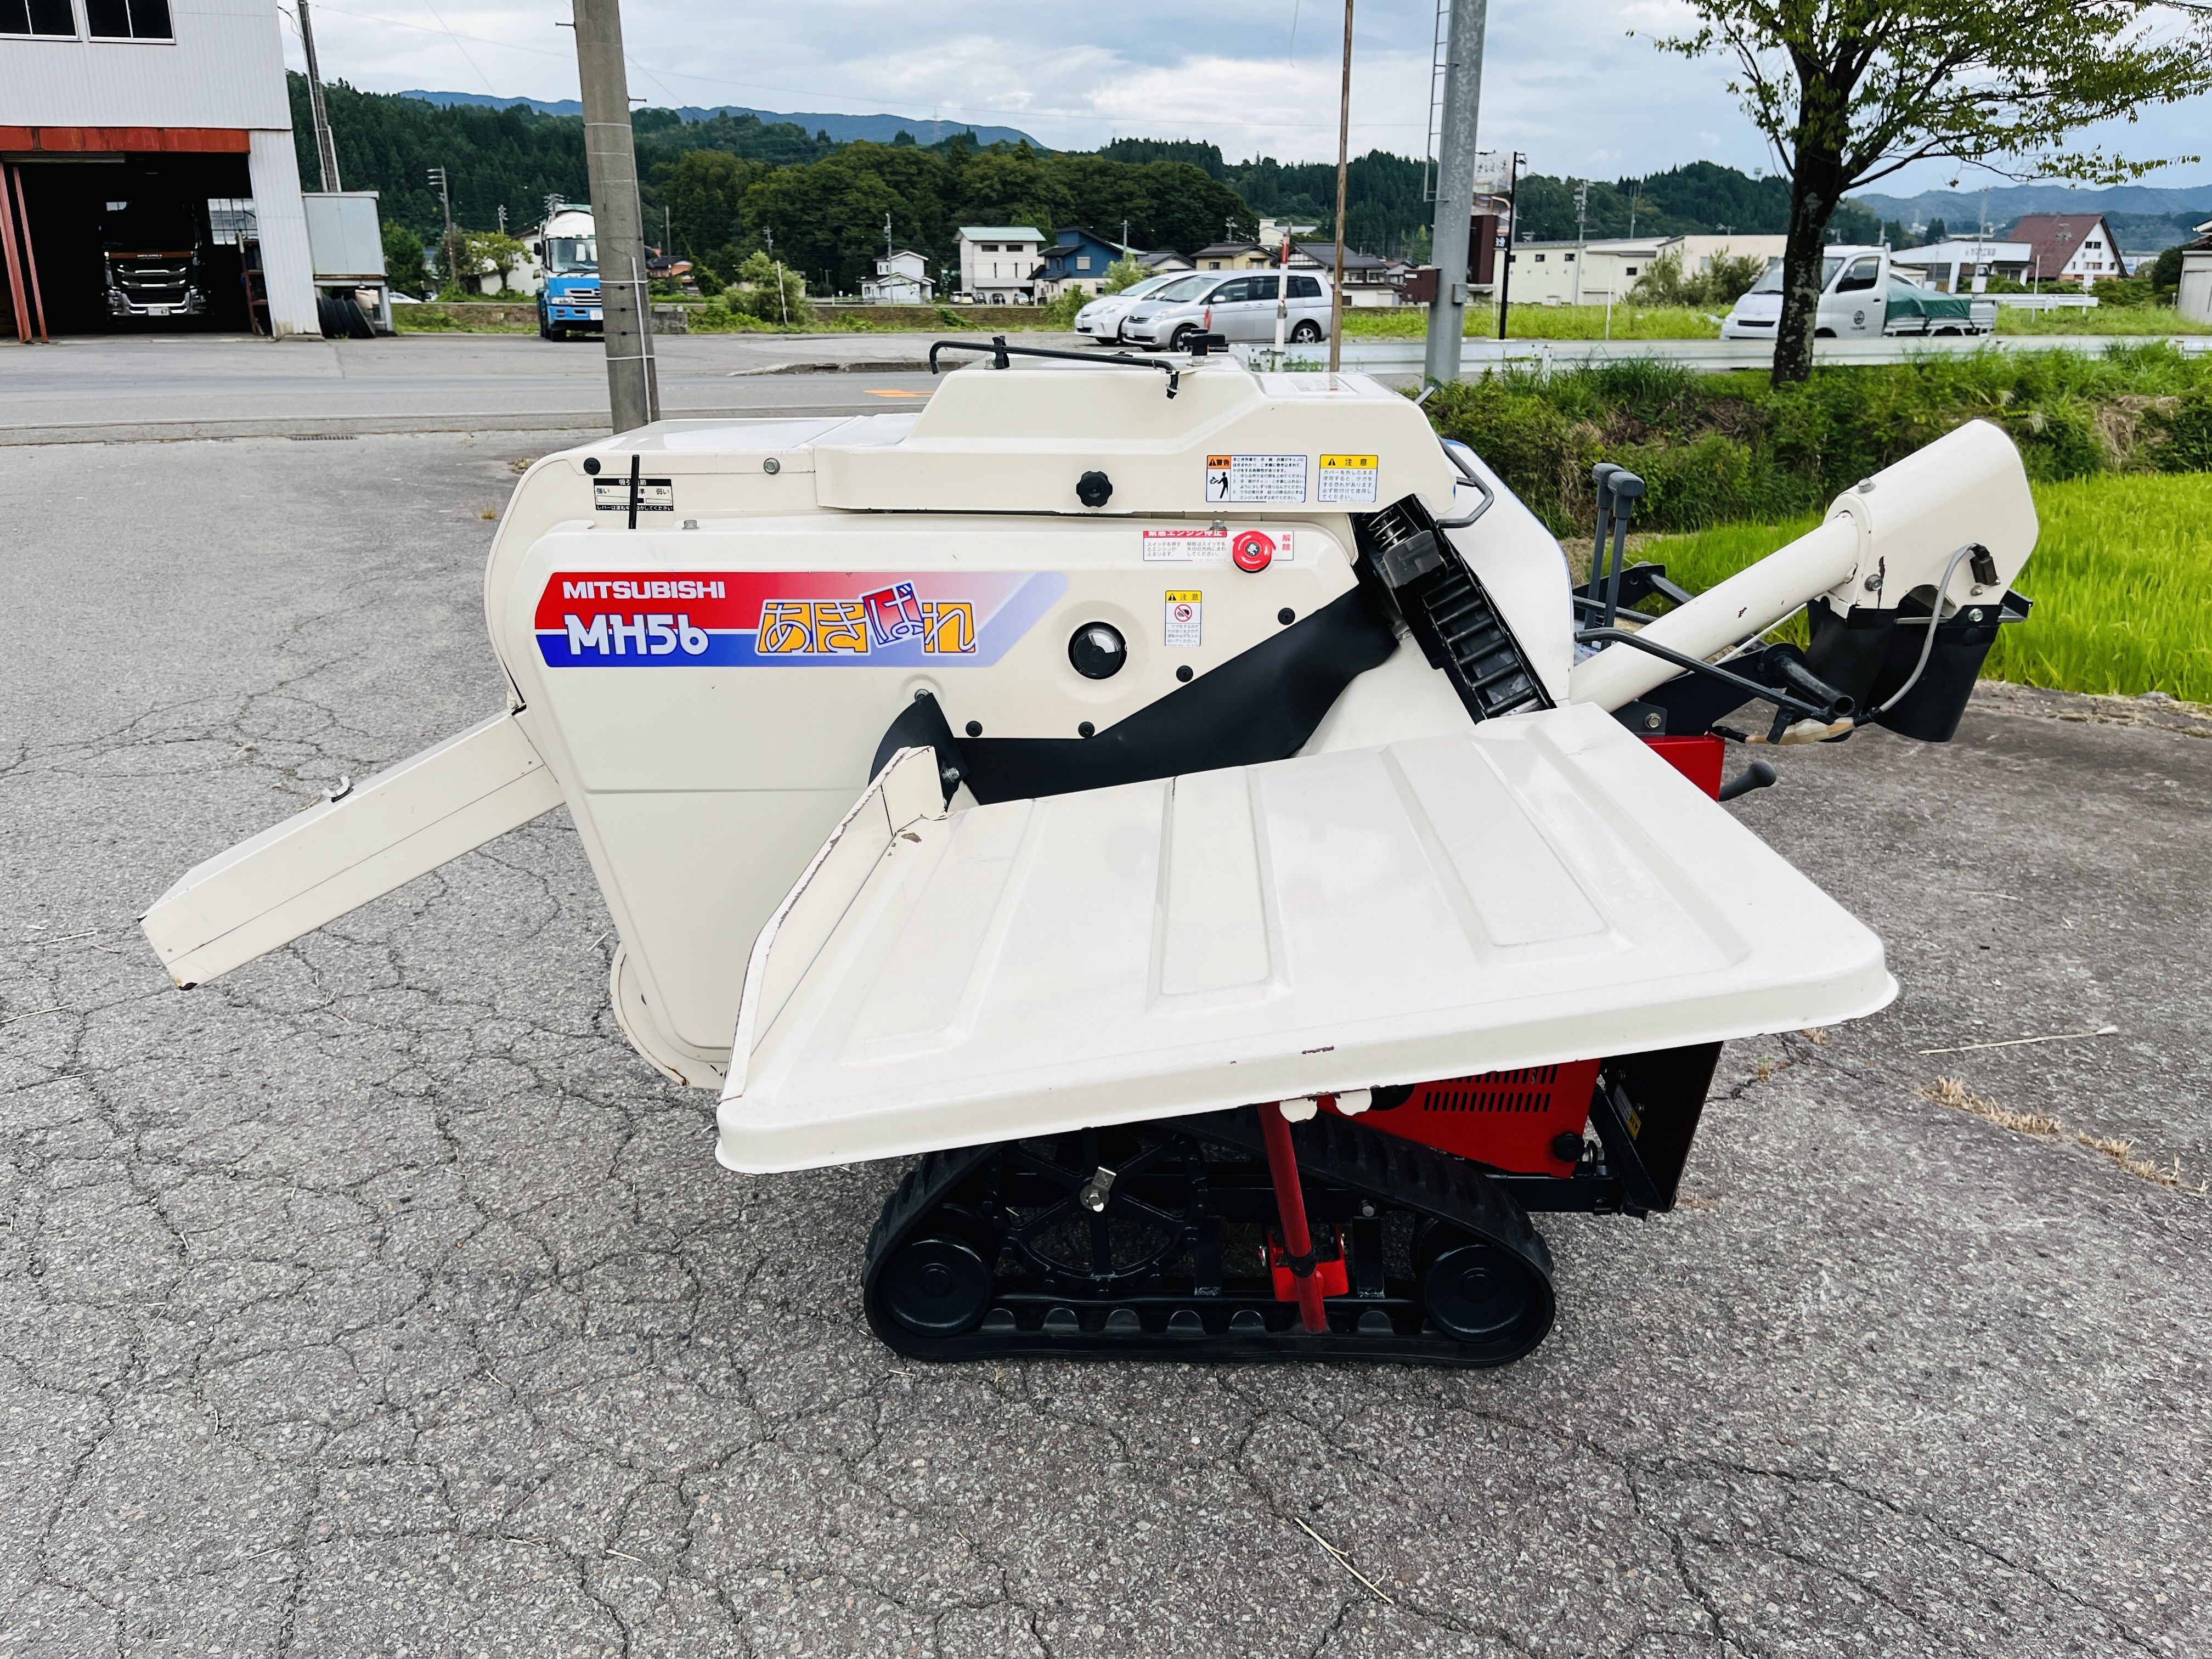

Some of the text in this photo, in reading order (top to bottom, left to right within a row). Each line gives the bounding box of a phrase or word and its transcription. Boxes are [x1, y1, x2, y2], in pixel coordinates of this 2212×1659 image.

[1345, 458, 1367, 466] 注意
[1282, 534, 1291, 551] 解除
[562, 581, 726, 599] MITSUBISHI
[1180, 592, 1199, 601] 注意
[758, 583, 977, 654] あきばれ
[563, 613, 709, 656] MH56
